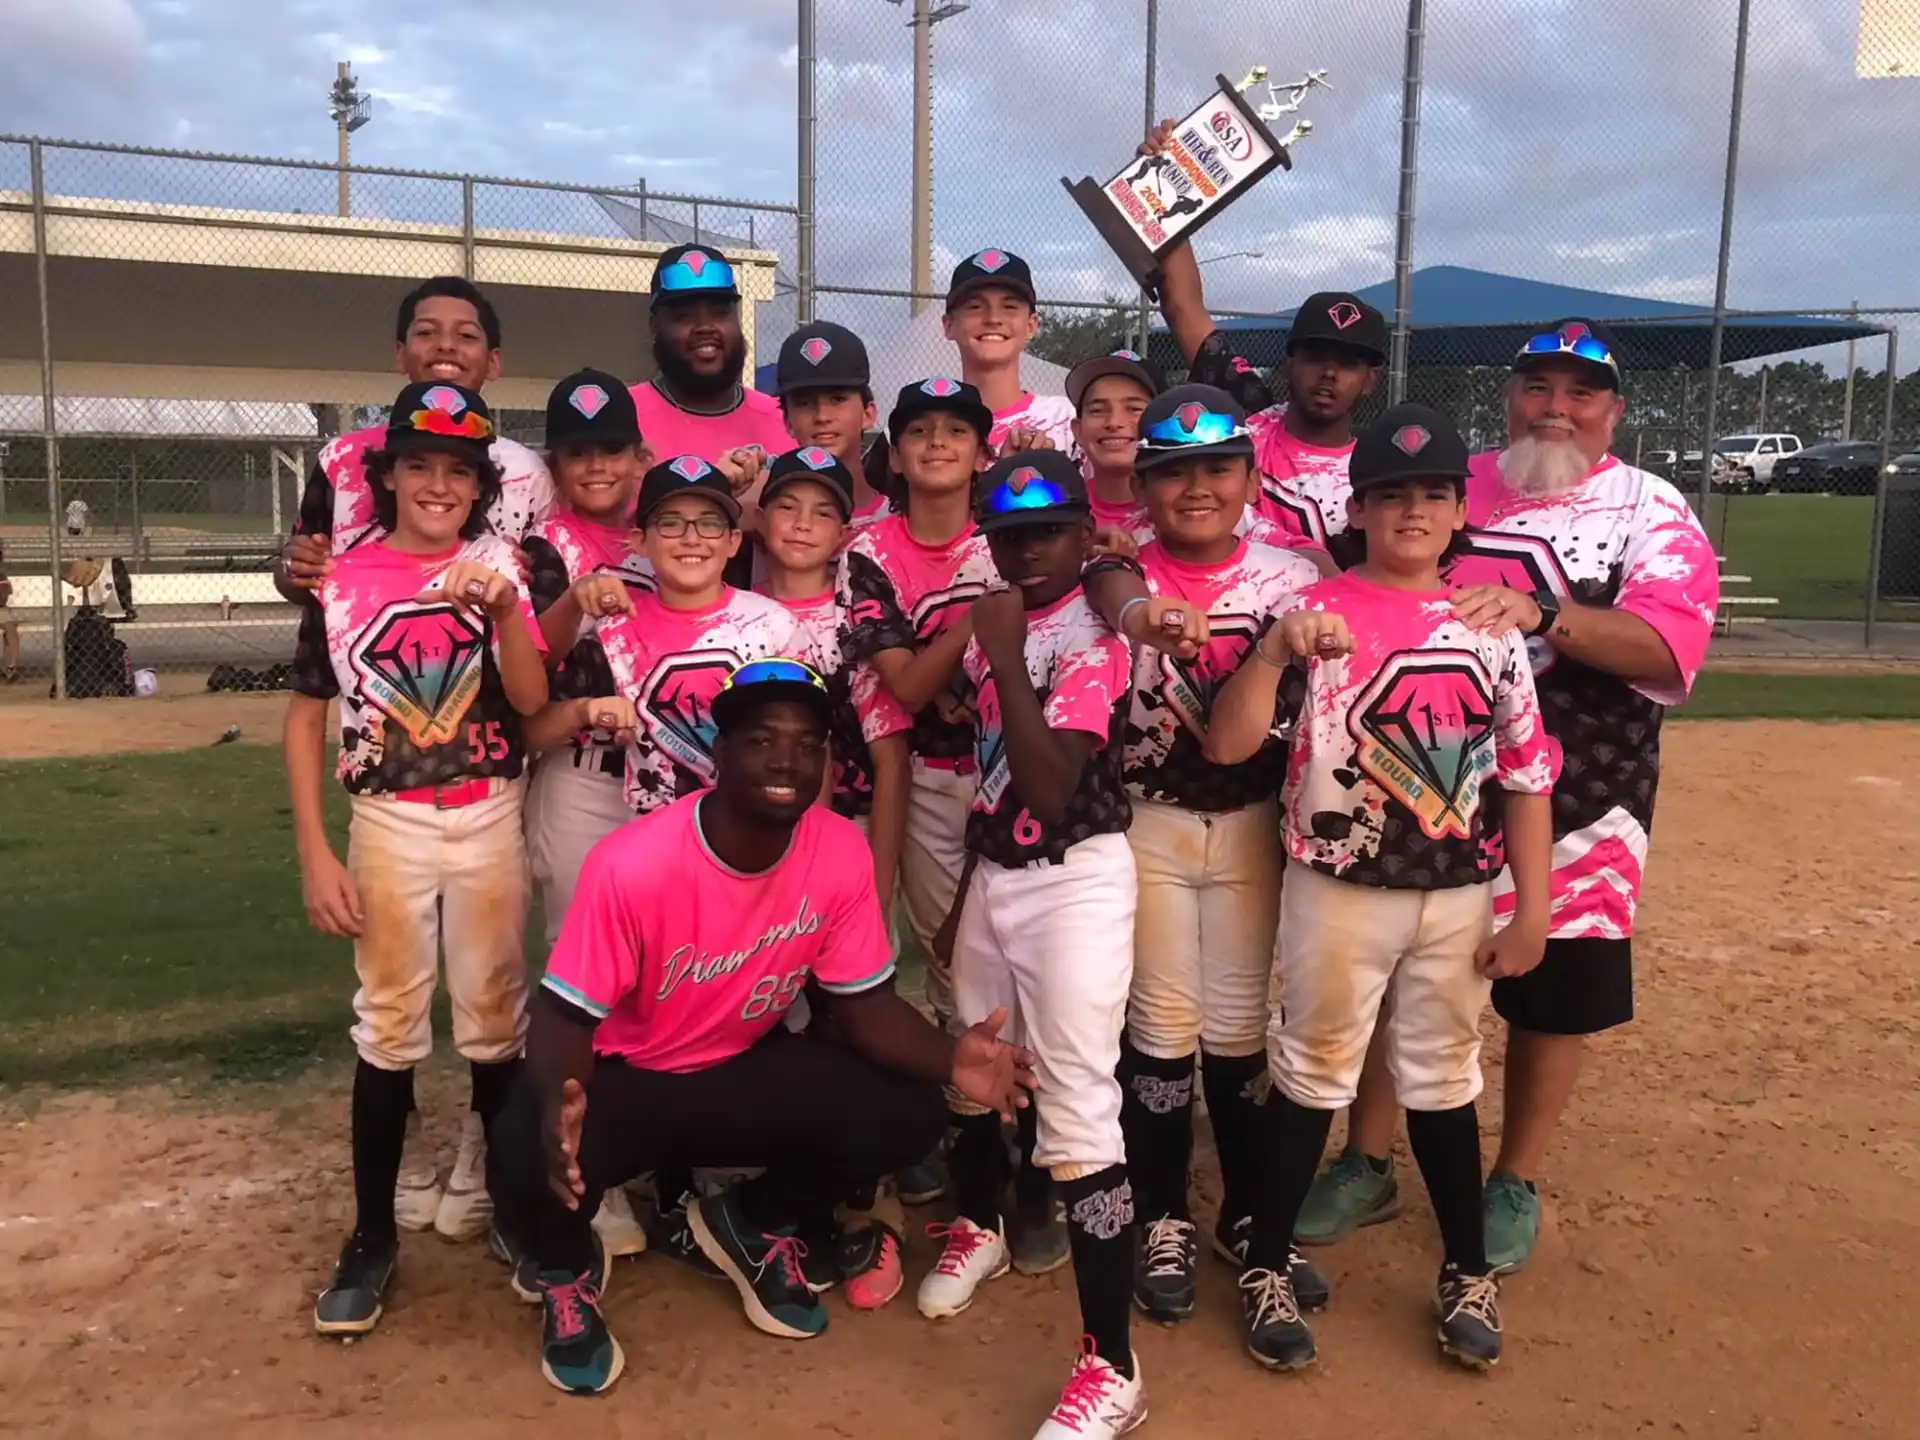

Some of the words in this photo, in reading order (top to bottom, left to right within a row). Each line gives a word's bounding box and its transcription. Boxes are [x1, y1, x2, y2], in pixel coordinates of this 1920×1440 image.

[370, 678, 412, 718] ROUND
[466, 721, 509, 764] 55
[1369, 747, 1424, 800] ROUND
[1012, 807, 1042, 846] 6
[655, 894, 823, 1001] Diamonds
[740, 964, 811, 1021] 85
